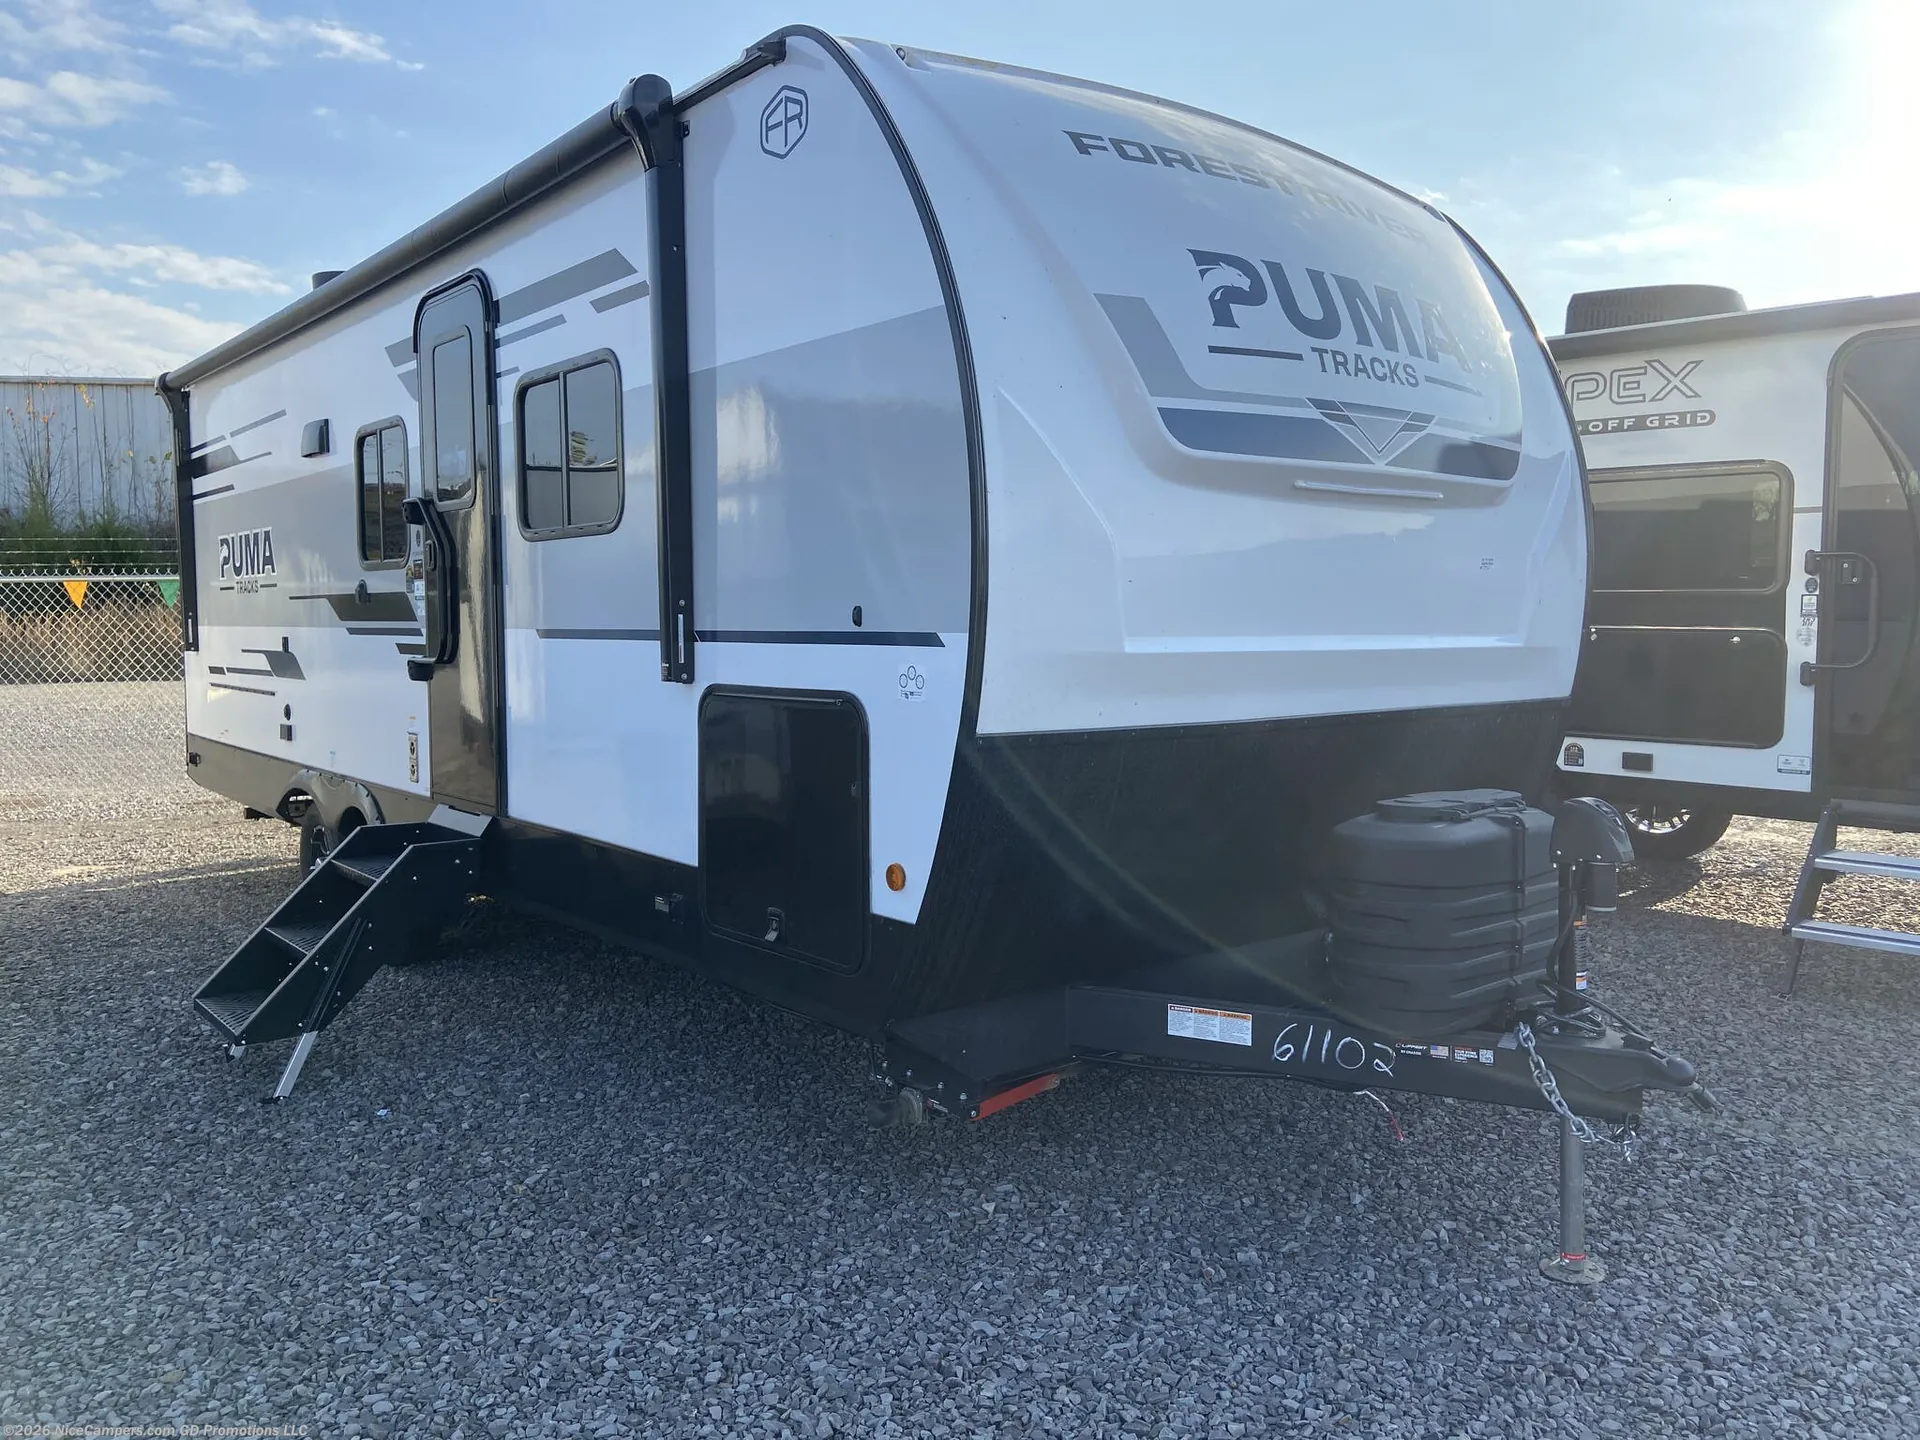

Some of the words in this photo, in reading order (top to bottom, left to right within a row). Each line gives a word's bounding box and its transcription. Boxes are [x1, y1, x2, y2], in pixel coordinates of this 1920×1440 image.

[1061, 129, 1294, 196] FOREST
[1186, 248, 1472, 374] PUMA
[1310, 346, 1420, 388] TRACKS
[1564, 358, 1704, 412] PEX
[1588, 417, 1636, 432] OFF
[1646, 412, 1711, 428] GRID
[218, 527, 277, 580] PUMA
[1272, 1023, 1396, 1078] 61102
